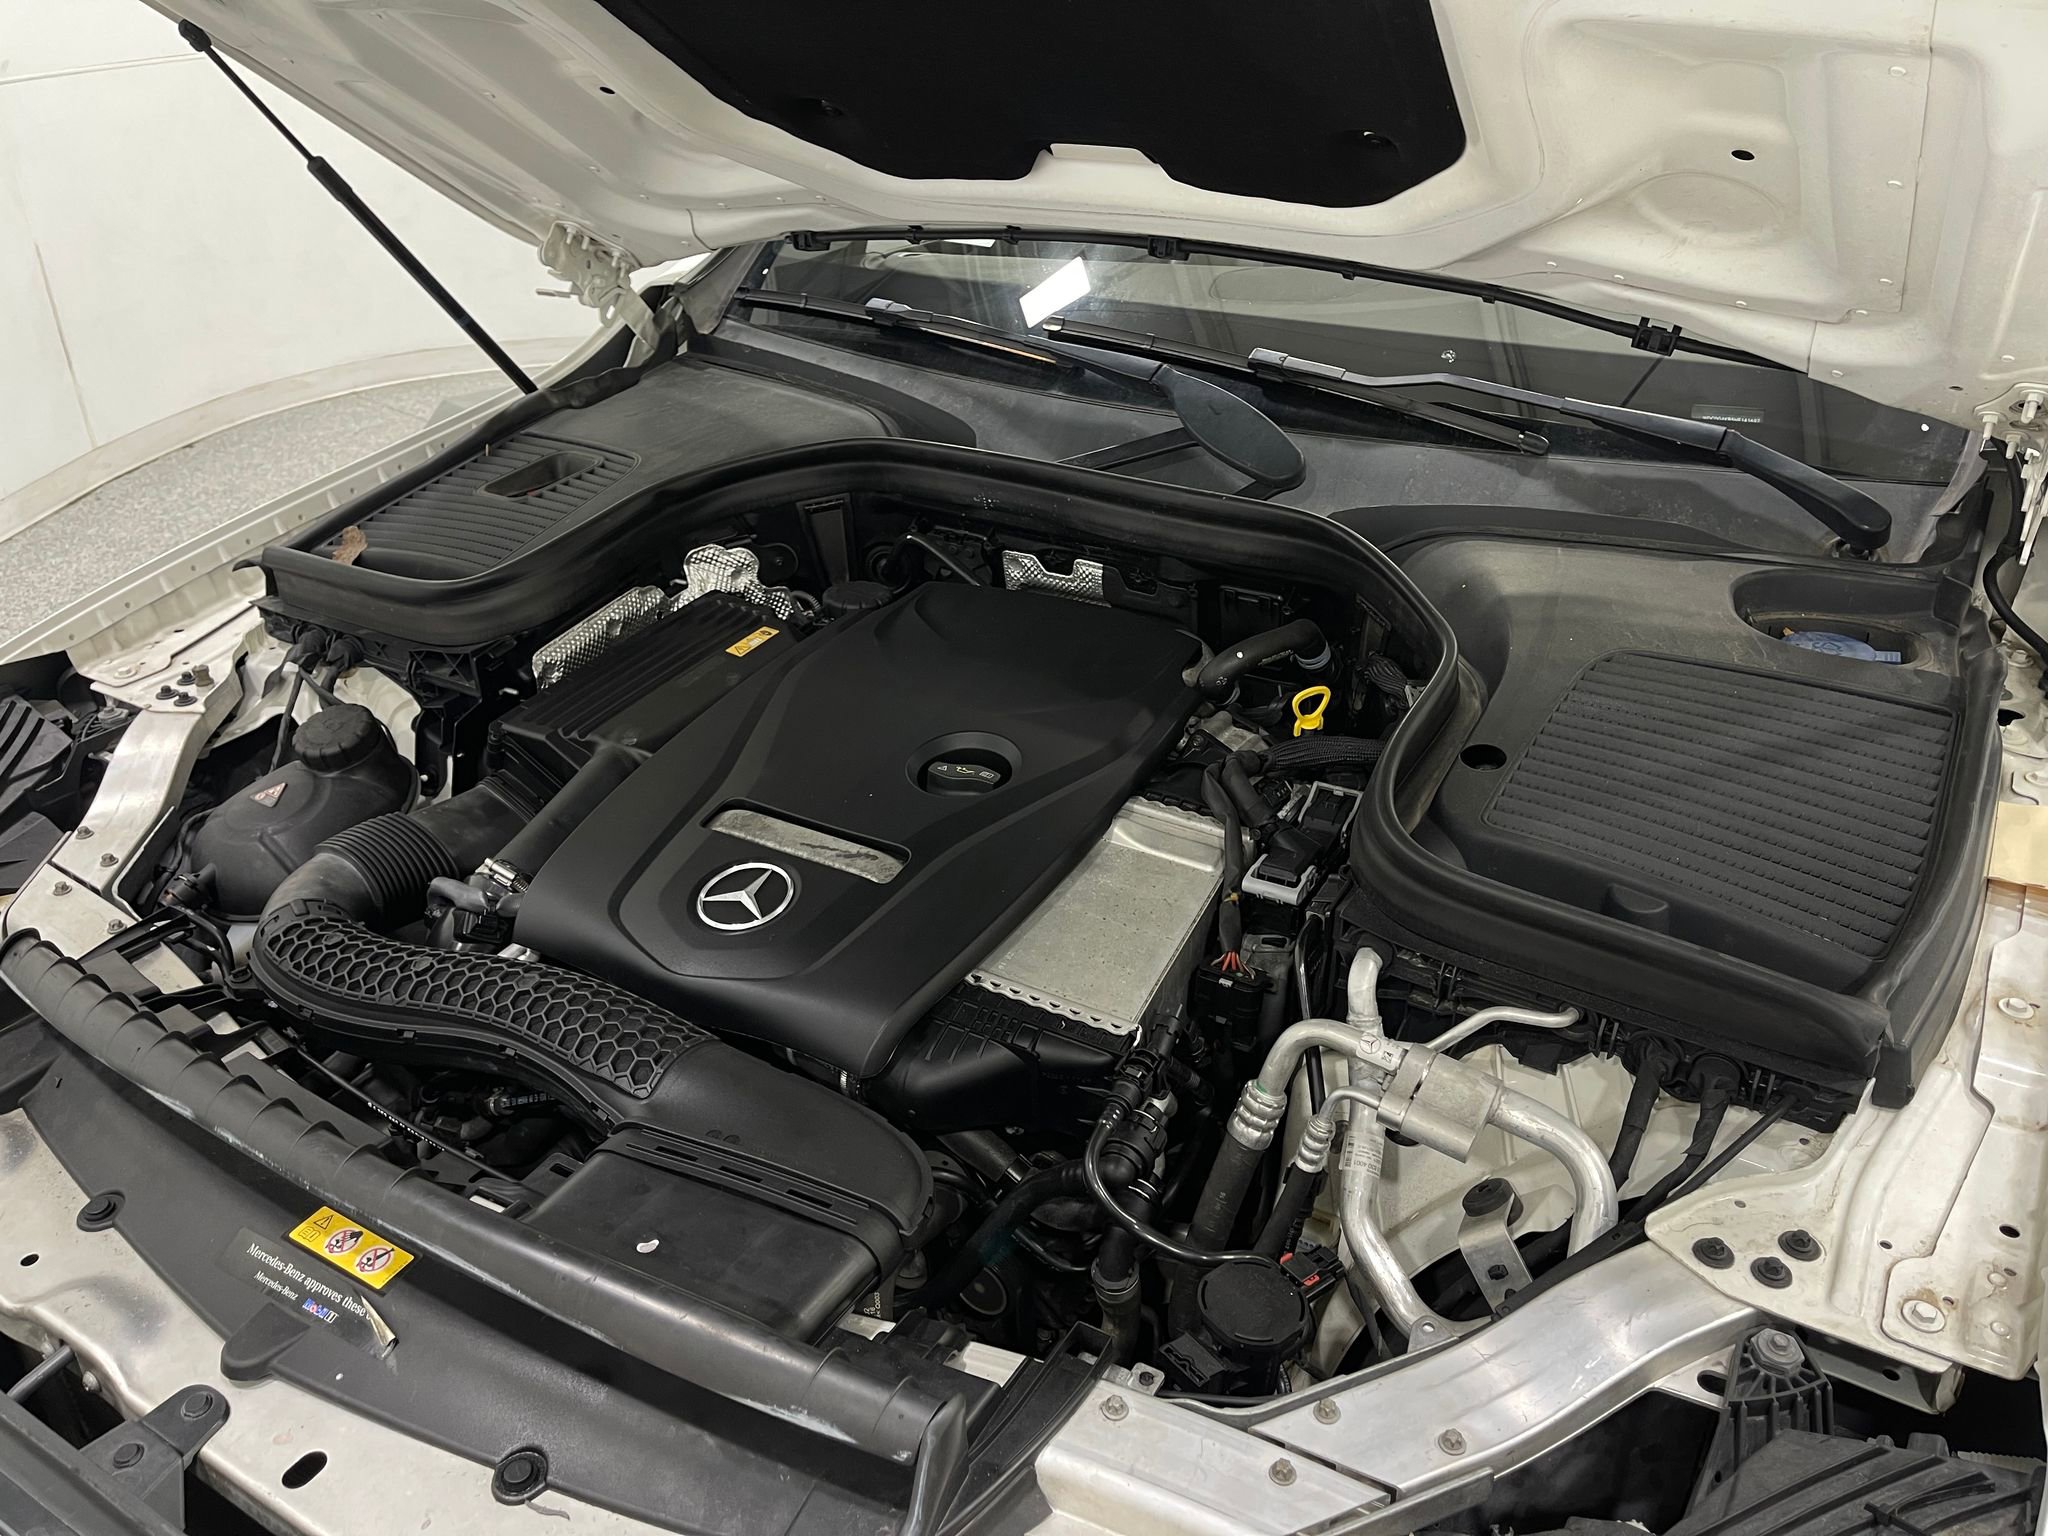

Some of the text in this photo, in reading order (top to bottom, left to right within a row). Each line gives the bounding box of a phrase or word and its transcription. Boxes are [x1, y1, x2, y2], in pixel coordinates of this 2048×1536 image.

[246, 1243, 367, 1318] Mercedes-Benz approves these
[254, 1270, 299, 1301] Mercedes-Benz
